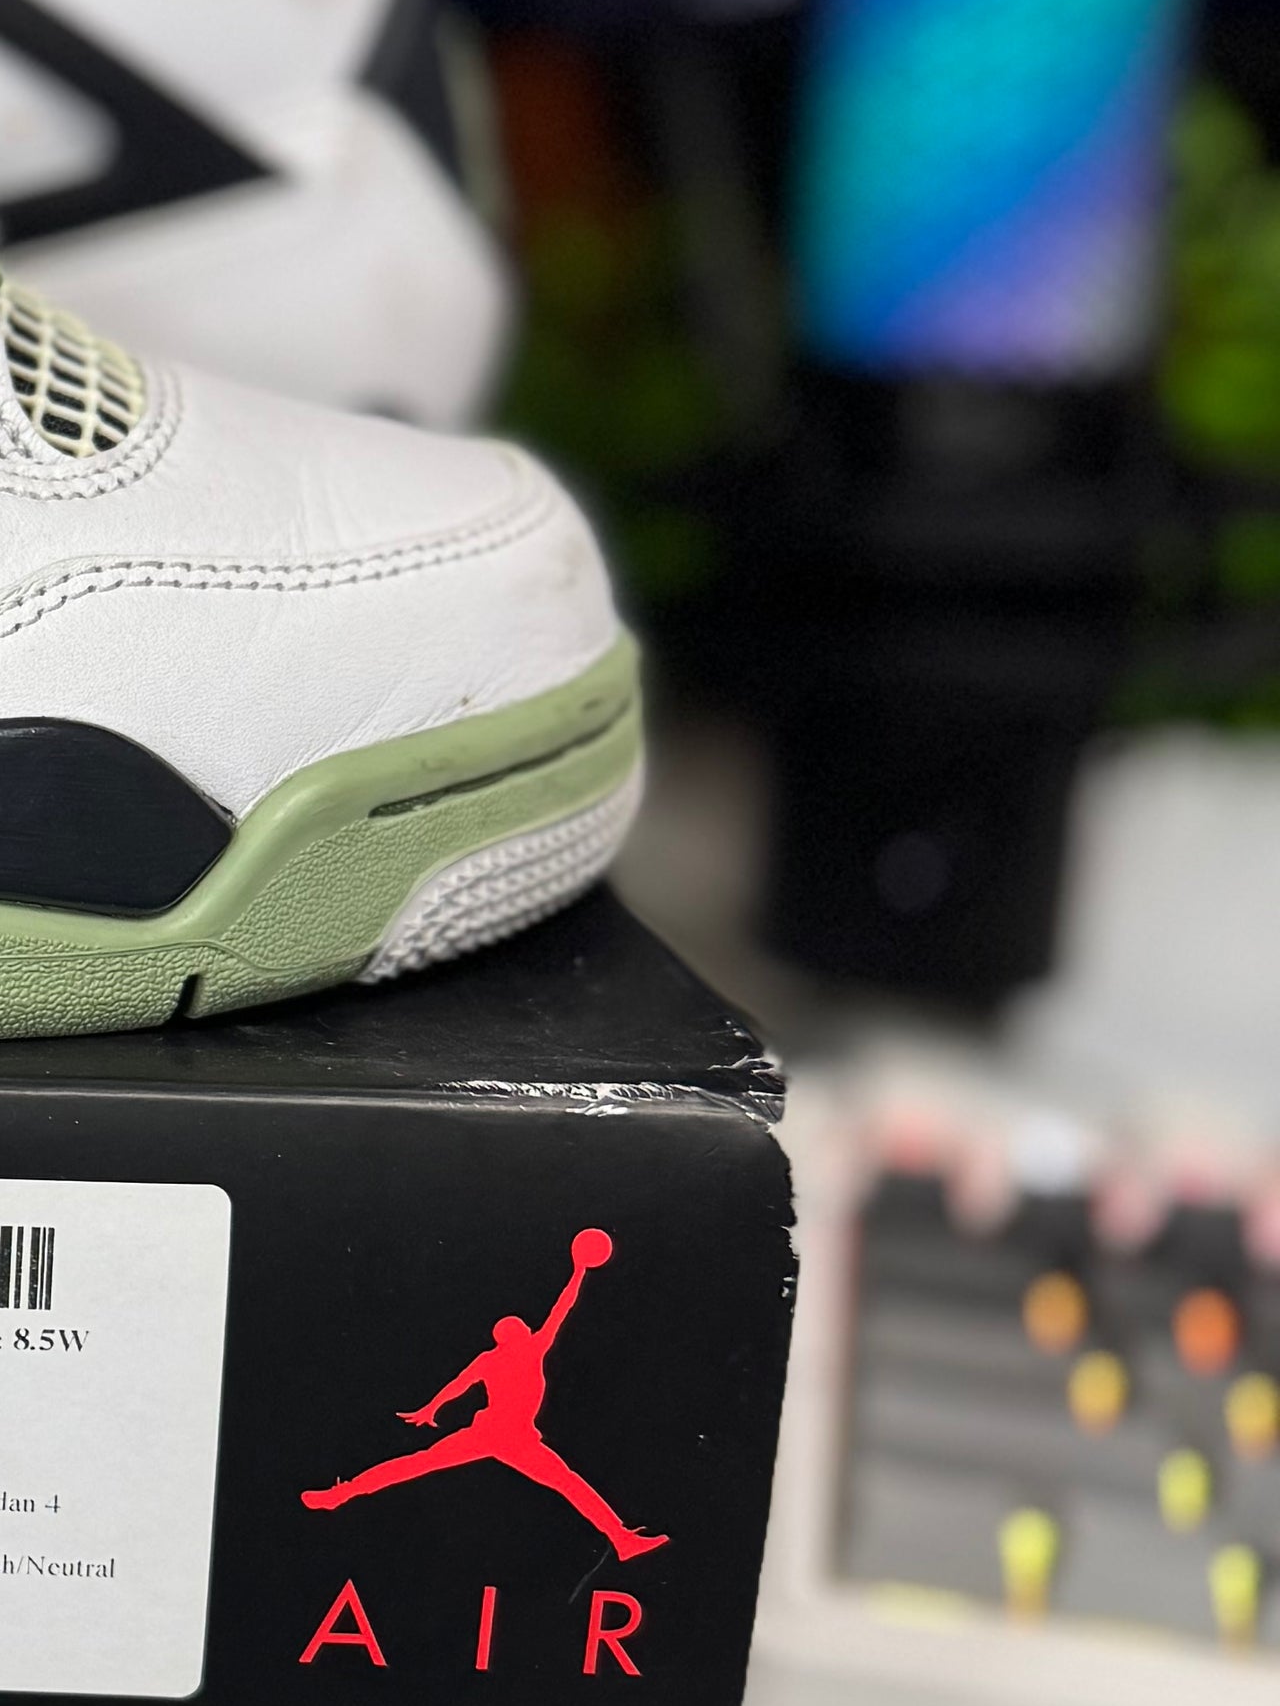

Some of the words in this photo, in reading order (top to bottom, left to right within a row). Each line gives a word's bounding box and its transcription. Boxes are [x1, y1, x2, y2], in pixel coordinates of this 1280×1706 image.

[12, 1327, 91, 1353] 8.5W
[44, 1493, 63, 1515] 4
[298, 1579, 642, 1677] AIR
